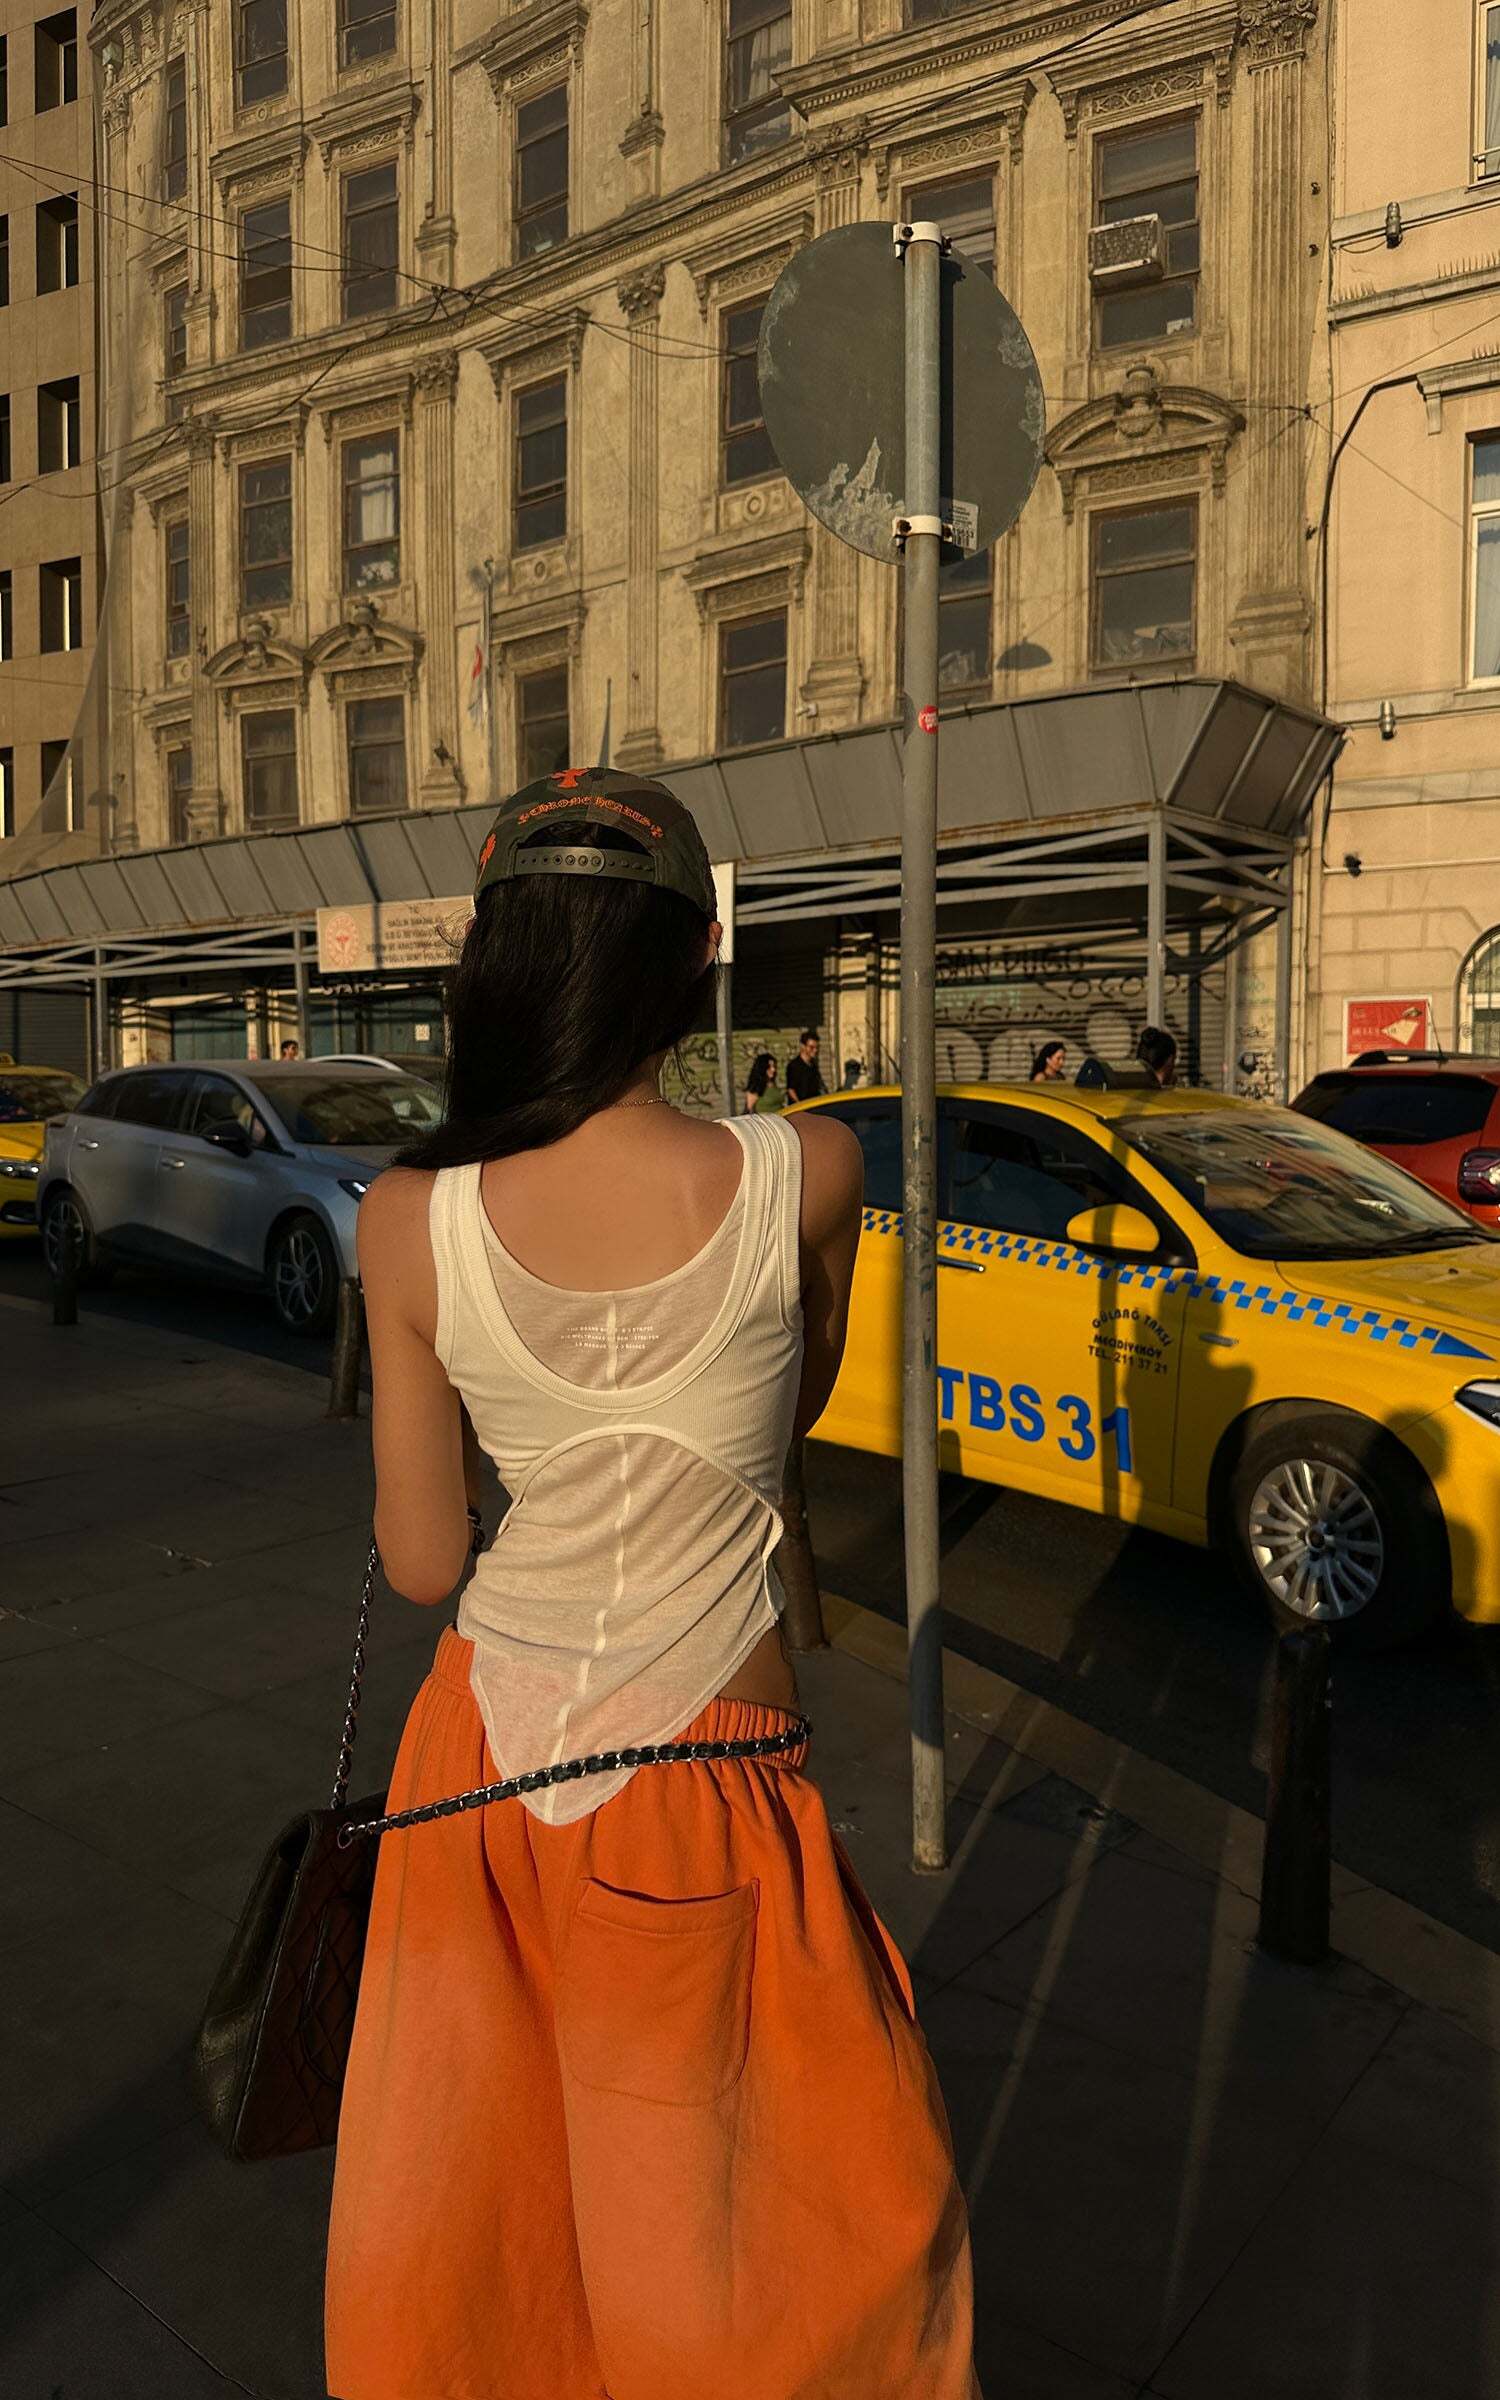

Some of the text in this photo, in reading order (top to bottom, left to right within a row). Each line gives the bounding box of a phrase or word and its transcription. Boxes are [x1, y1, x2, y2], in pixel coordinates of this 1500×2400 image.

[529, 796, 651, 826] CHROME HEARTS
[1112, 1351, 1134, 1366] 211
[937, 1365, 1132, 1473] TBS 31
